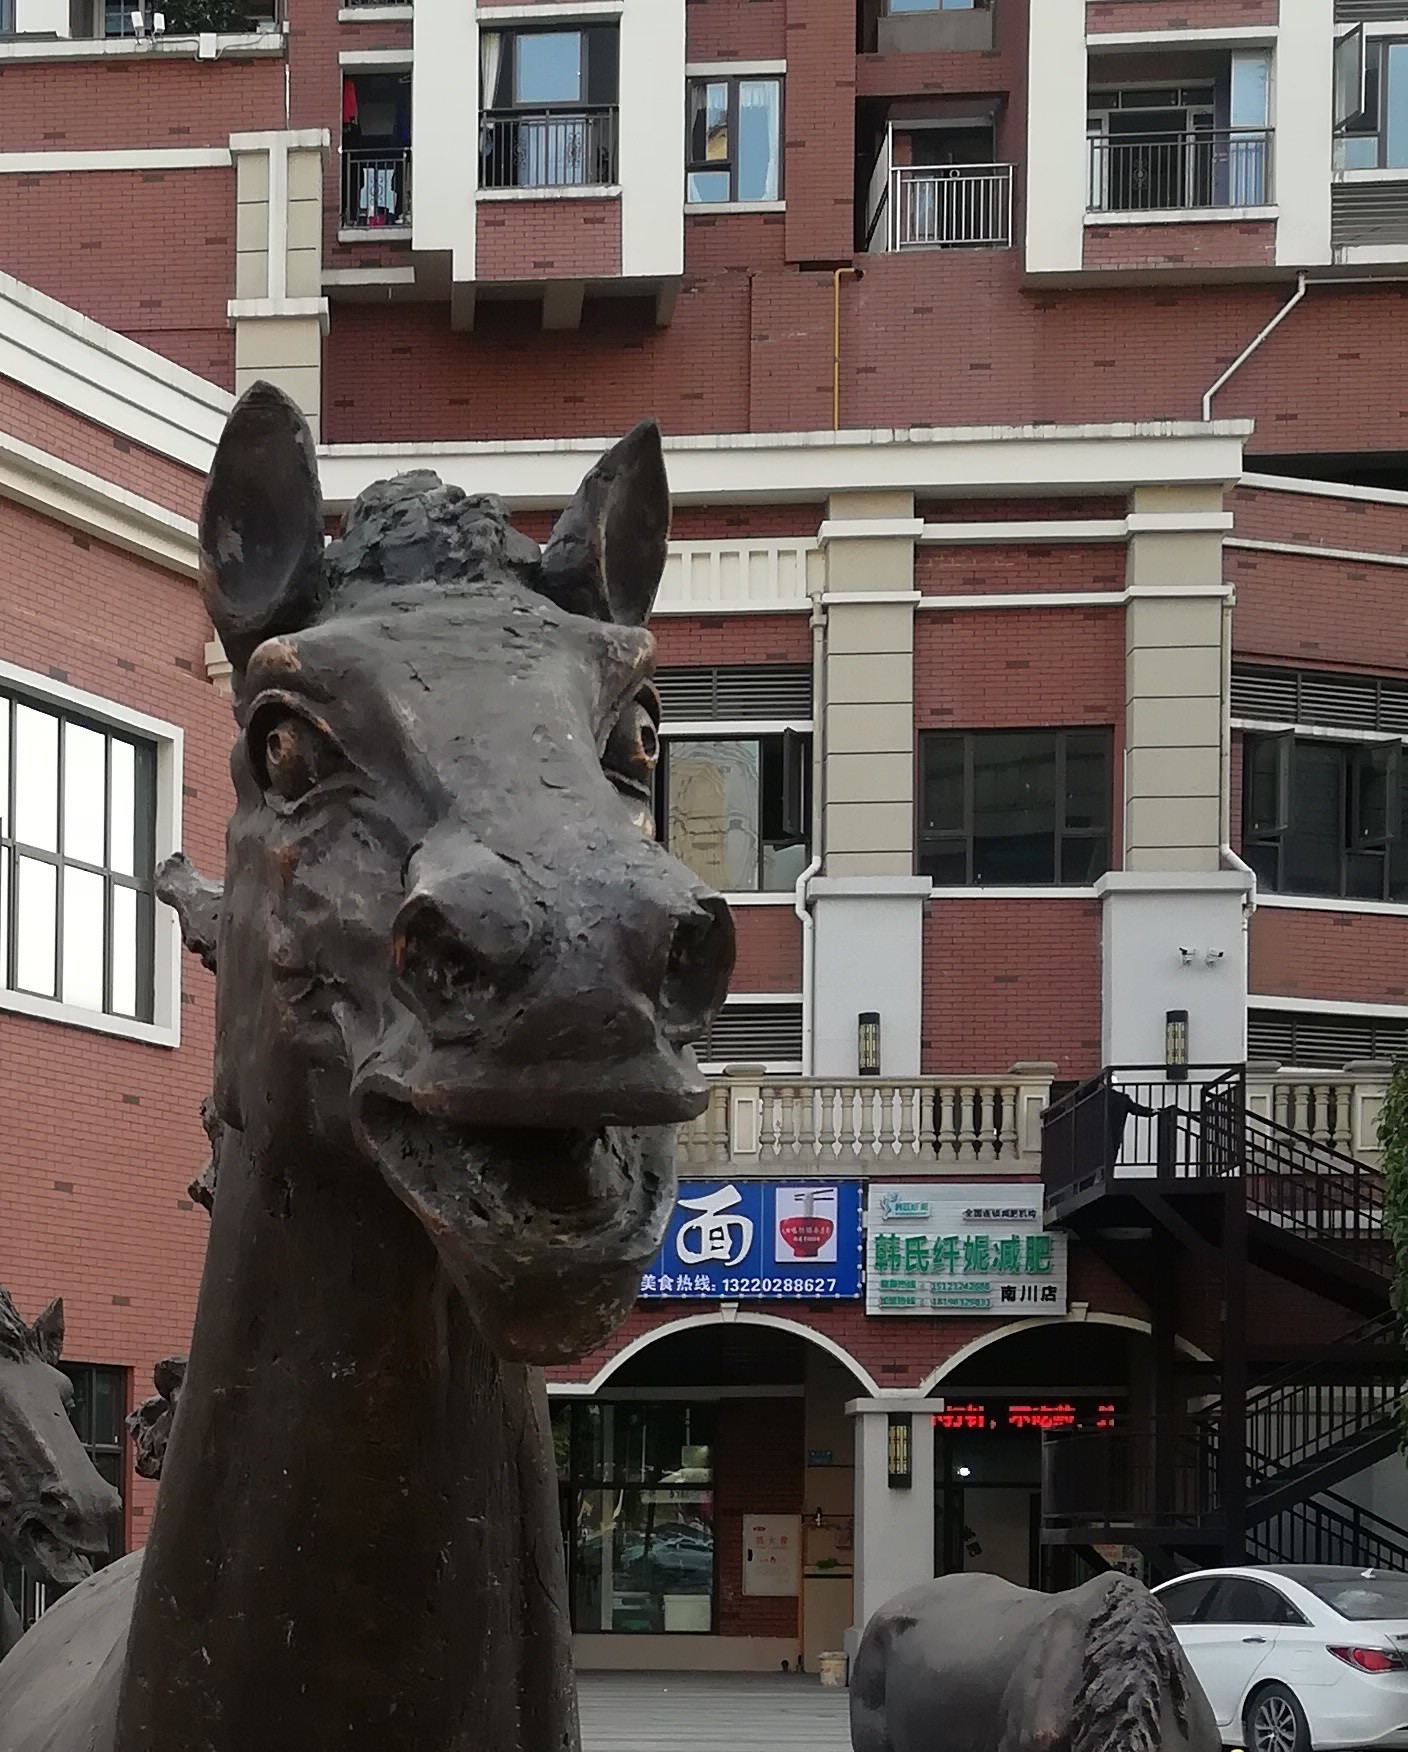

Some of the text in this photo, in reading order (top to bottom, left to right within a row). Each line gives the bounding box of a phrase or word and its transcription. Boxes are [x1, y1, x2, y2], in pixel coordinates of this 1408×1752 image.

[964, 1208, 1037, 1219] 全国连锁减肥机构
[676, 1184, 753, 1266] 面
[874, 1233, 1053, 1275] 韩氏纤妮减肥
[722, 1278, 837, 1292] 13220288627
[1000, 1285, 1058, 1303] 南川店
